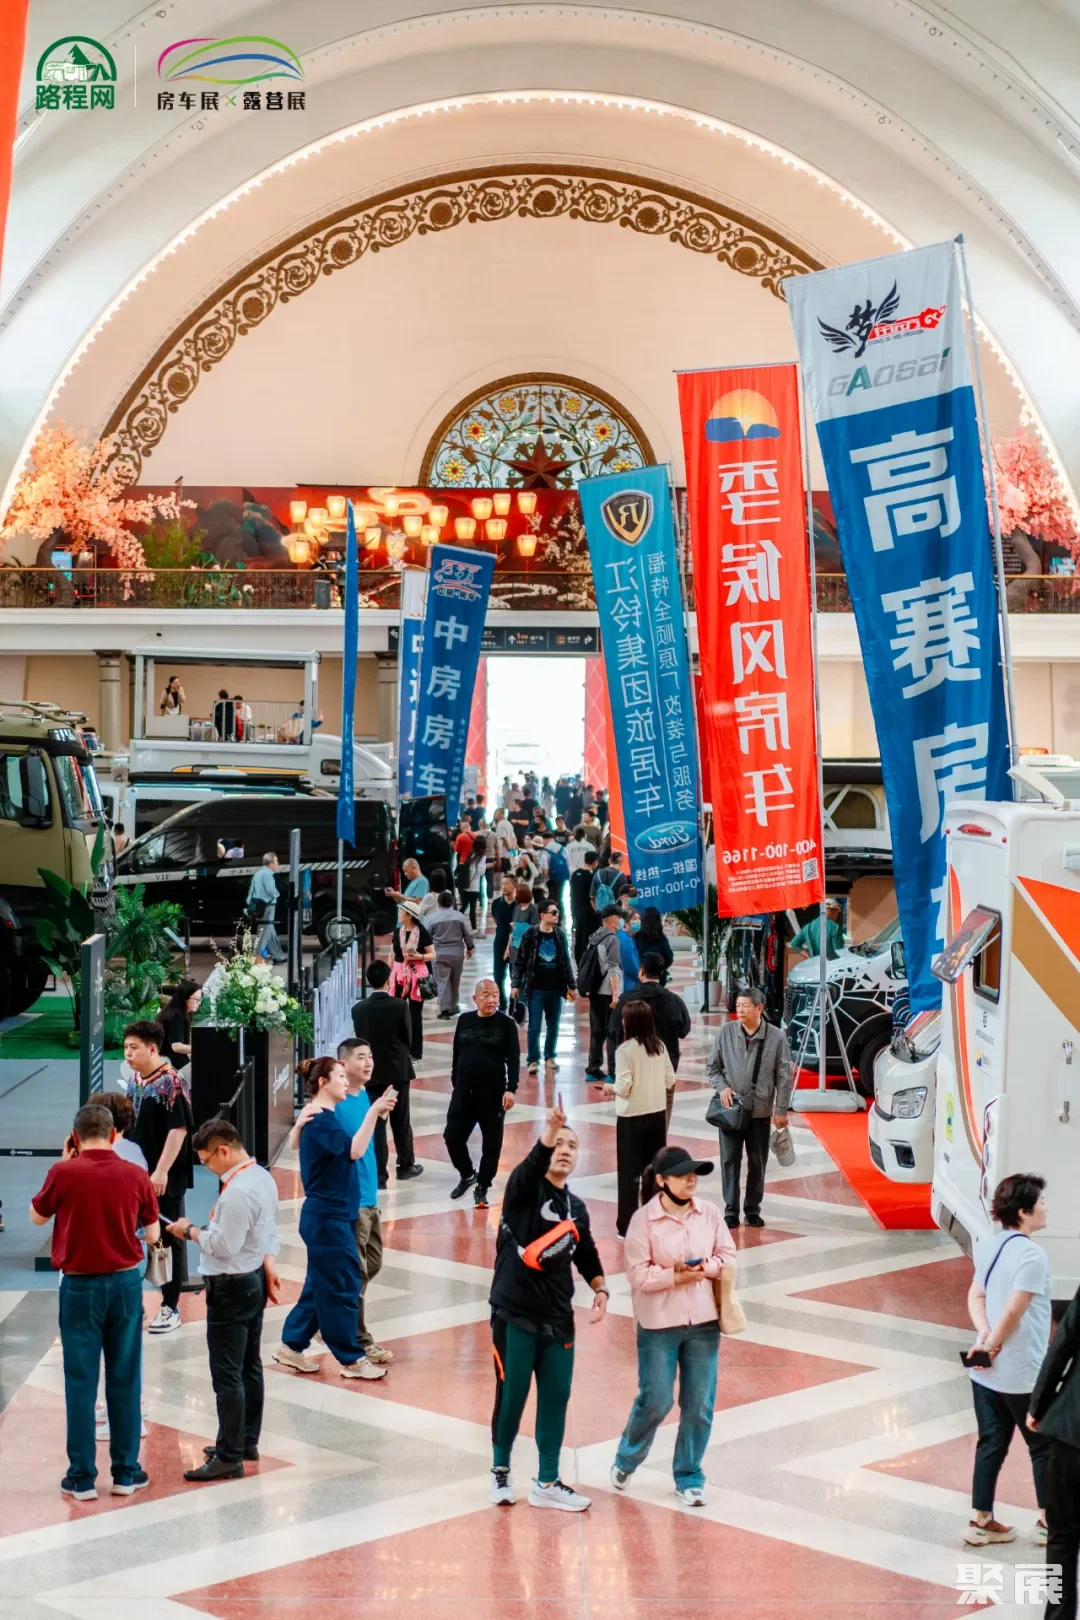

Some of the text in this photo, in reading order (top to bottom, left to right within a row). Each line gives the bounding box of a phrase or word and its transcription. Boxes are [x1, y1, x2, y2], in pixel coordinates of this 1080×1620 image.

[416, 615, 470, 796] 中房房车
[848, 426, 989, 970] 高赛房
